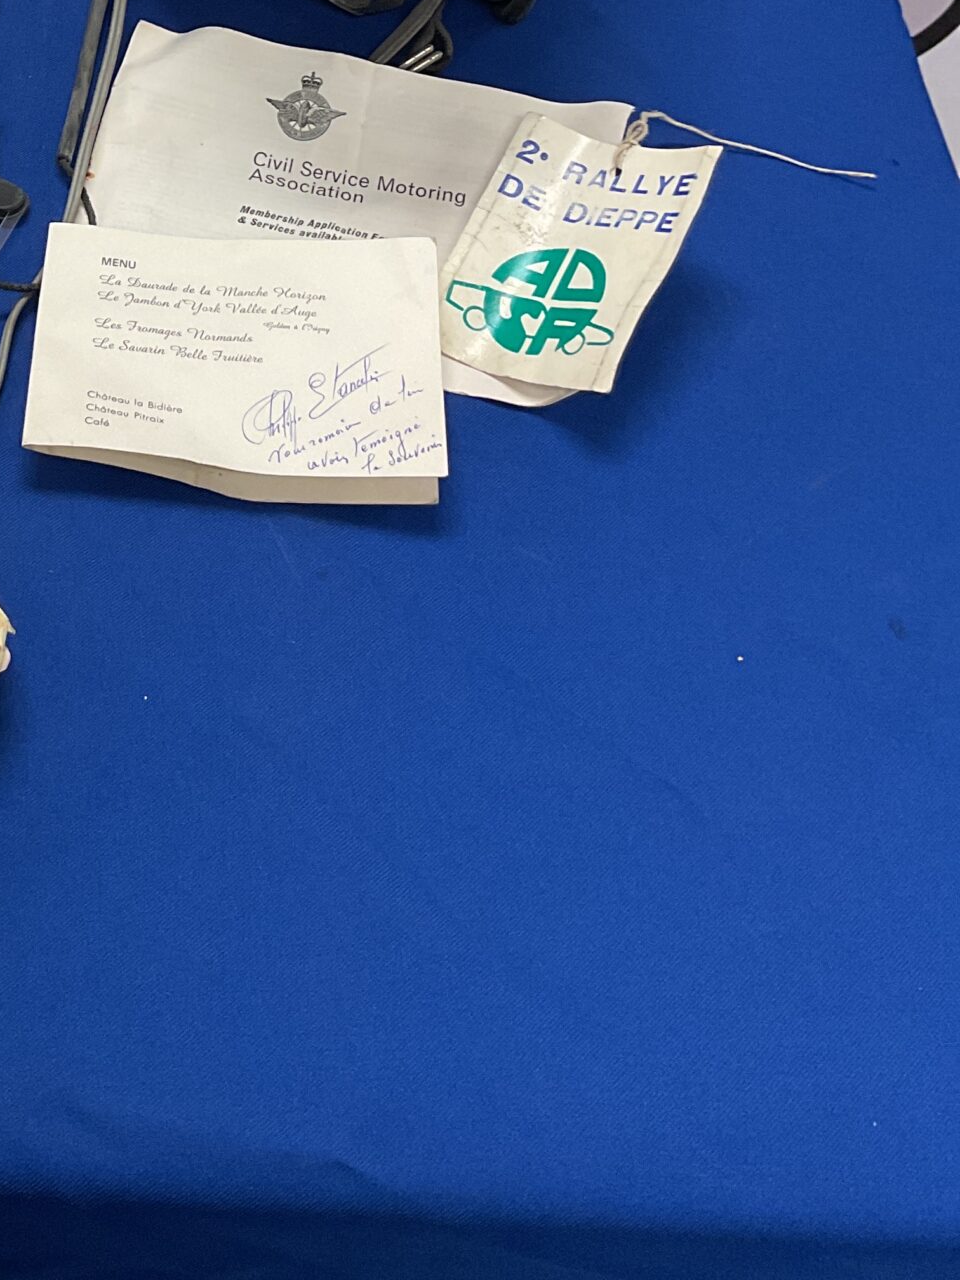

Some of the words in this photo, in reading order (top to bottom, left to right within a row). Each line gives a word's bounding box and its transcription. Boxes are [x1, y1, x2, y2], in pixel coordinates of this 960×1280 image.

[248, 168, 365, 204] Association
[253, 151, 294, 173] Civil
[300, 160, 370, 188] Service
[377, 175, 467, 207] Motoring
[562, 161, 698, 196] RALLYE
[497, 173, 547, 212] DE
[563, 202, 680, 234] DIEPPE
[238, 216, 246, 224] &
[250, 218, 296, 235] Services
[239, 205, 305, 227] Membership
[307, 218, 368, 239] Application
[101, 256, 137, 269] MENU
[98, 290, 119, 302] Le
[124, 293, 170, 307] Jambon
[226, 302, 267, 314] Vallée
[99, 274, 121, 286] La
[128, 277, 178, 292] Daurade
[183, 281, 195, 293] de
[200, 285, 211, 296] la
[217, 286, 268, 297] Manche
[273, 287, 327, 304] Horizon
[94, 317, 122, 329] Les
[127, 320, 183, 339] Fromages
[187, 328, 253, 343] Normands
[92, 337, 115, 349] Le
[119, 340, 166, 355] Savarin
[170, 345, 208, 361] Belle
[212, 350, 264, 364] Fruitière
[86, 403, 129, 417] Château
[87, 390, 130, 404] Château
[134, 398, 143, 407] la
[84, 416, 110, 427] Café
